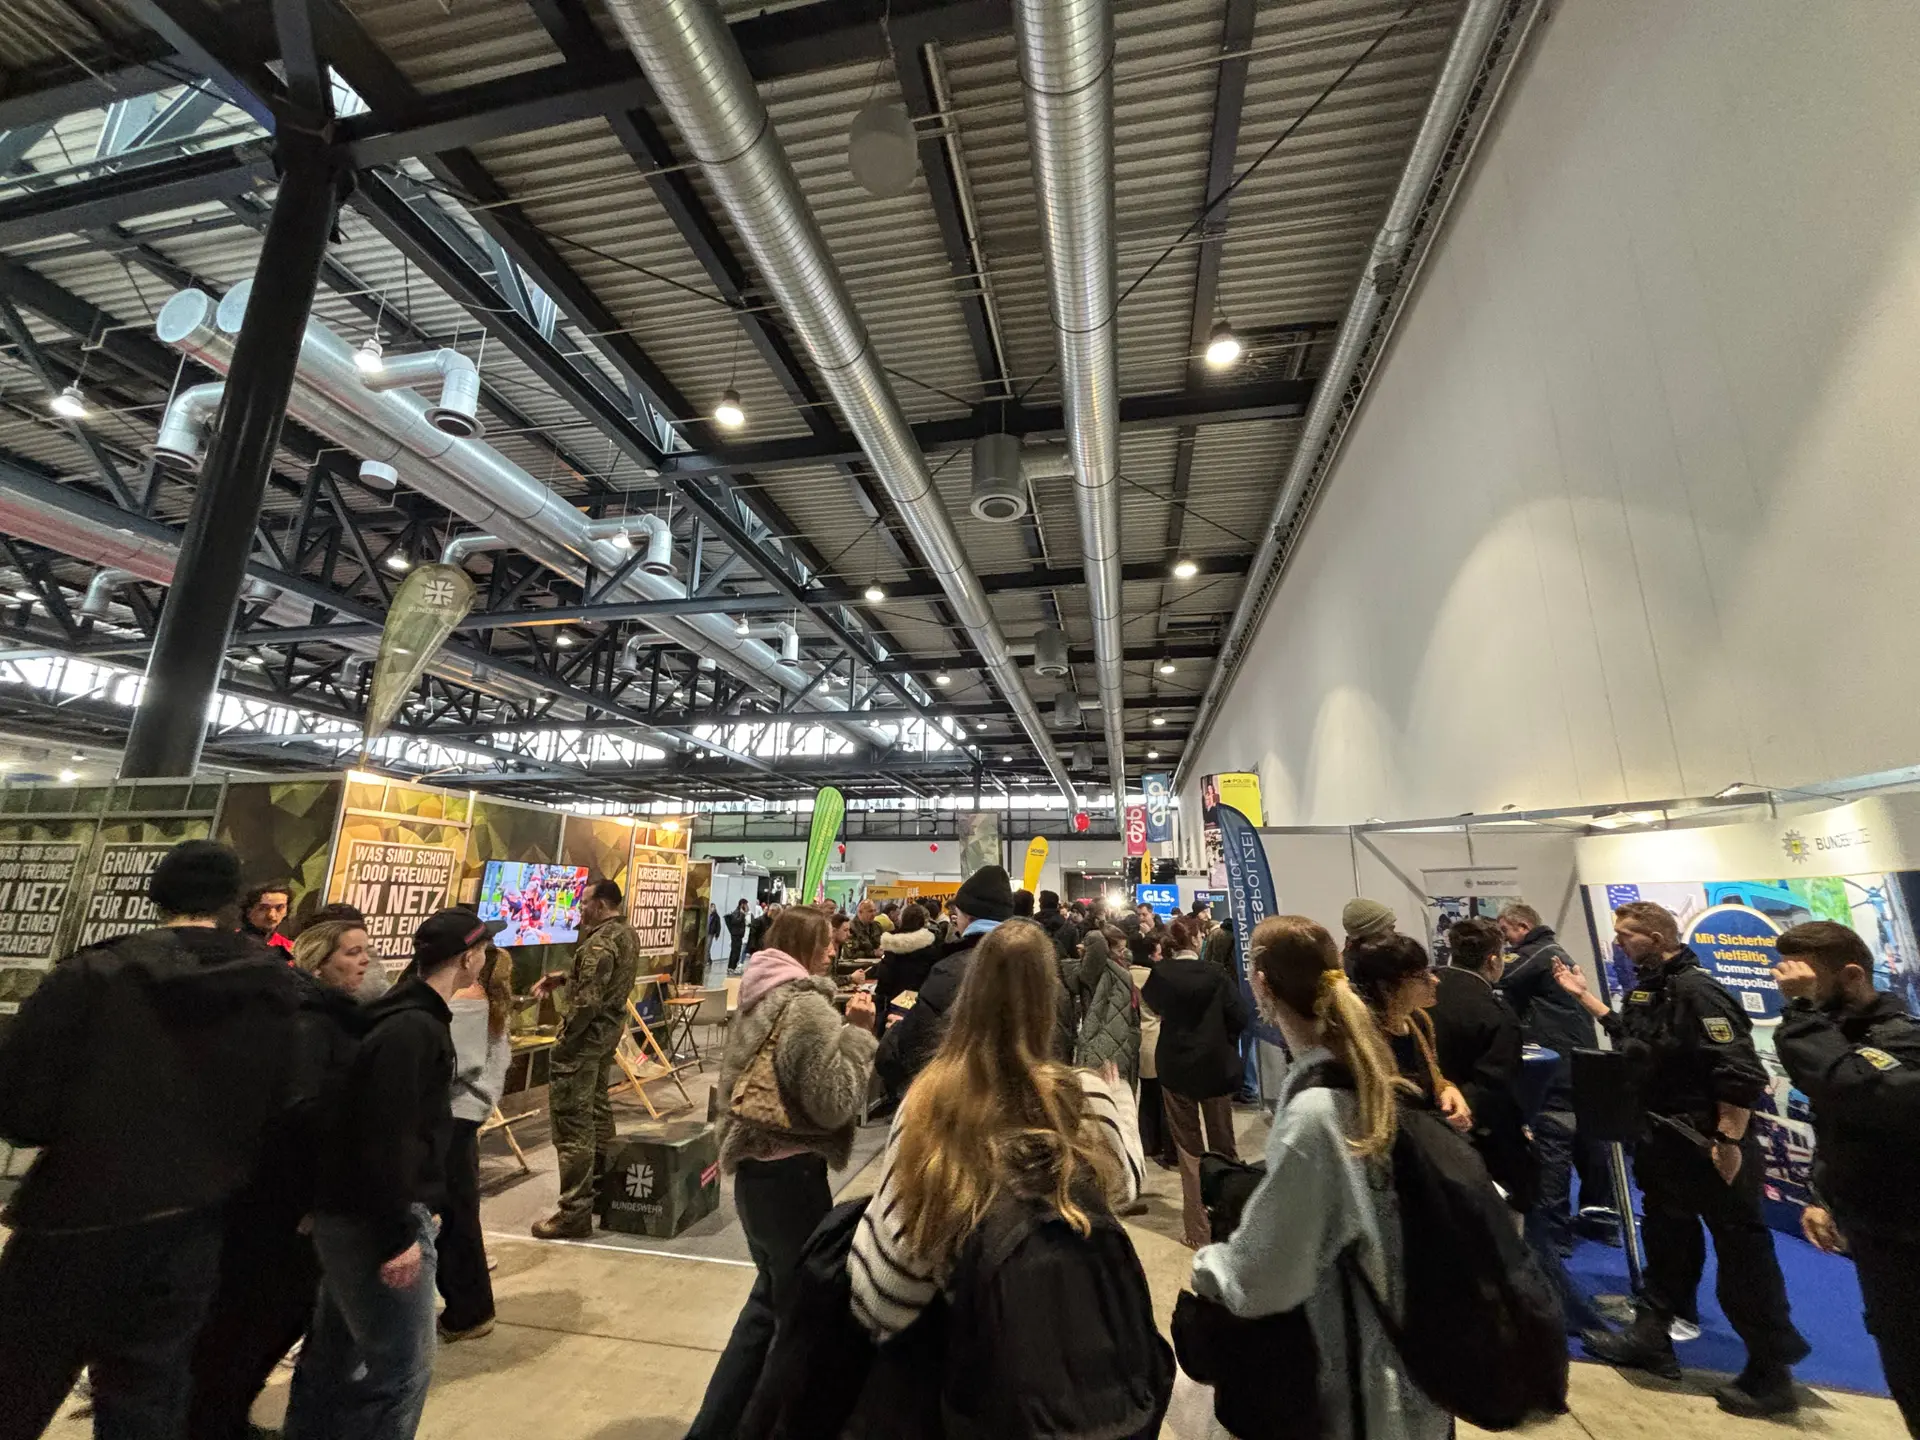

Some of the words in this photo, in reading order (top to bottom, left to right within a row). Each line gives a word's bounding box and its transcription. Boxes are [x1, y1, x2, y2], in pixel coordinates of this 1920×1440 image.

[355, 845, 384, 862] WAS
[386, 847, 413, 864] SIND
[416, 850, 451, 867] SCHON
[20, 864, 73, 879] FREUNDE
[351, 863, 389, 882] 1.000
[391, 866, 448, 884] FREUNDE
[97, 876, 117, 890] IST
[115, 876, 141, 890] AUCH
[12, 882, 67, 912] NETZ
[89, 891, 123, 919] FÜR
[346, 884, 381, 915] IM
[386, 885, 446, 915] NETZ
[635, 891, 679, 908] ABWARTEN
[18, 913, 59, 933] EINEN
[633, 908, 655, 928] UND
[656, 909, 676, 927] TEE-
[1695, 933, 1716, 944] Mit
[1718, 933, 1777, 947] Sicherhei
[611, 1200, 663, 1215] BUNDESWEHR
